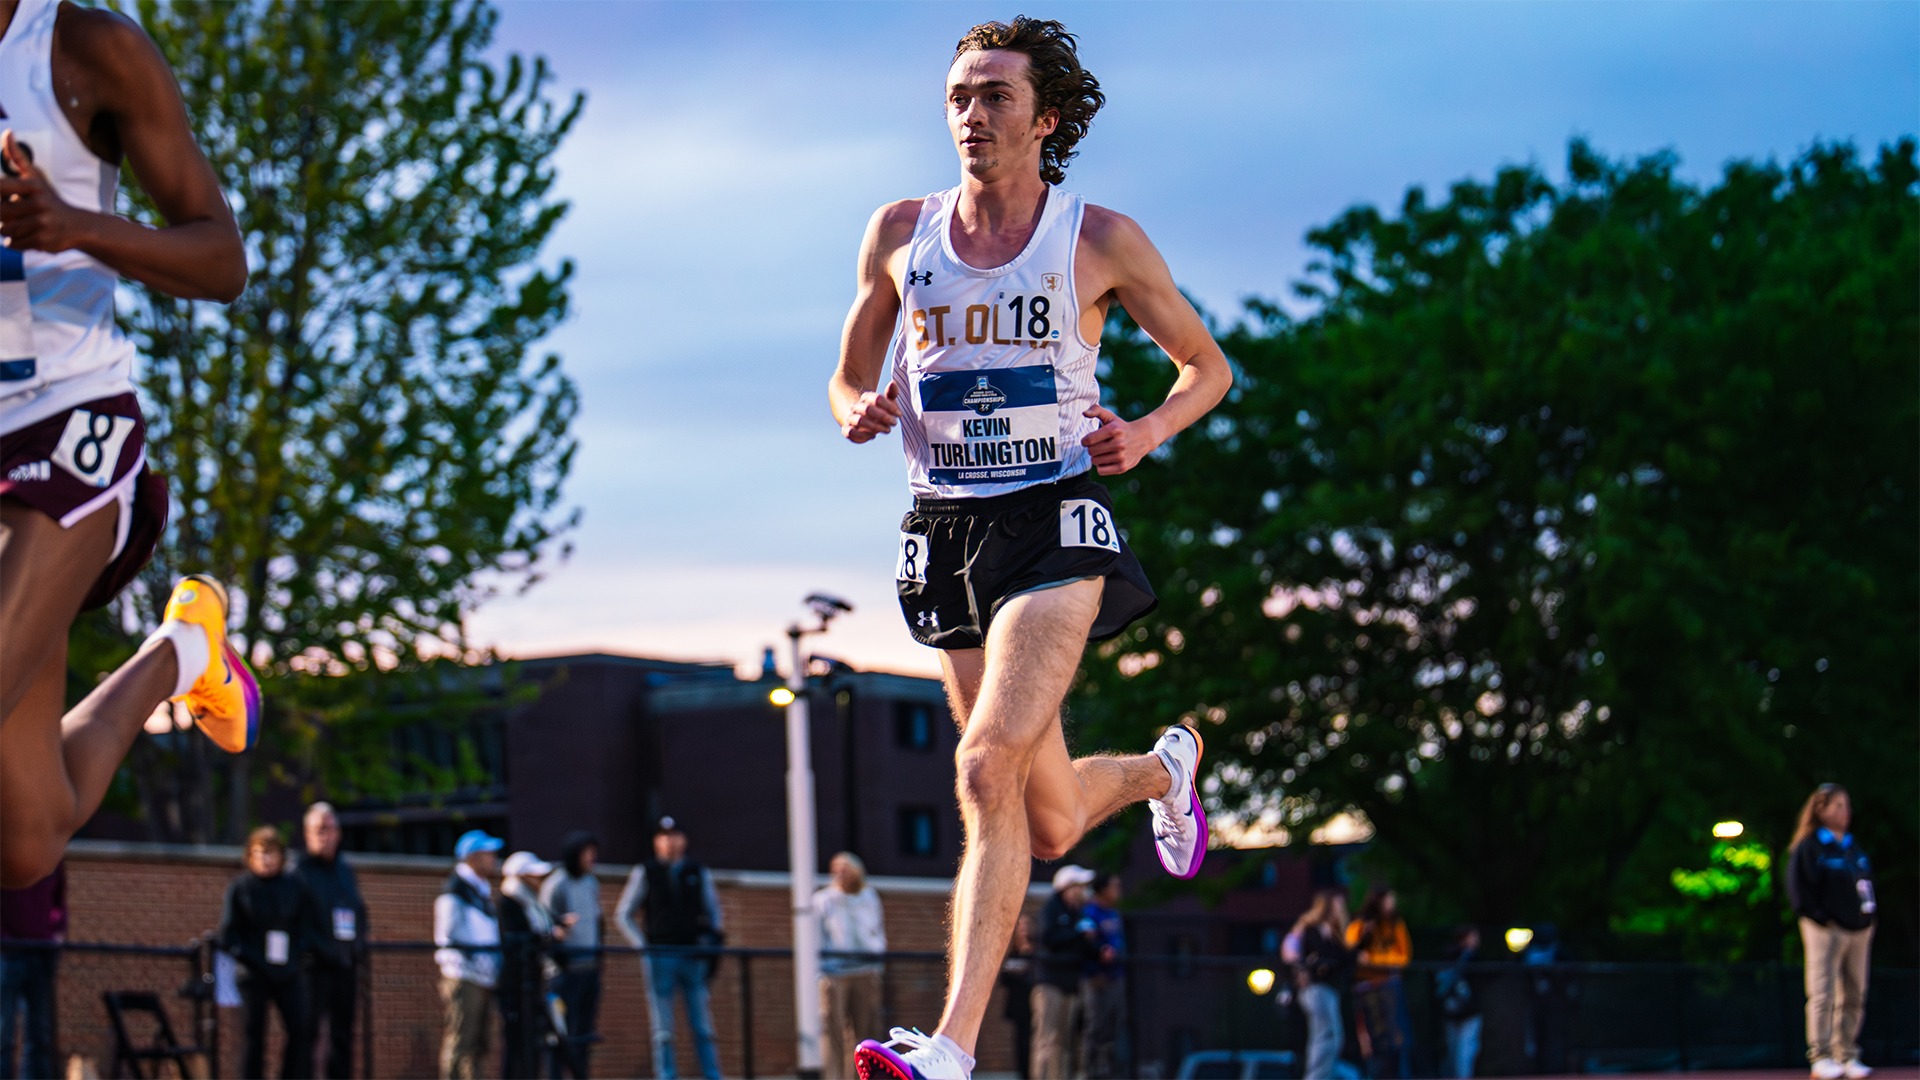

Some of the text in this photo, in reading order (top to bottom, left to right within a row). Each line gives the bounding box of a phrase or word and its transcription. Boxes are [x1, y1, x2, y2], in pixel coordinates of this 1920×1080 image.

[912, 303, 1049, 351] ST. OL
[1008, 295, 1050, 339] 18
[964, 396, 1005, 404] CHAMPIONSHIPS
[74, 411, 114, 474] 8
[962, 417, 1011, 437] KEVIN
[931, 437, 1056, 467] TURLINGTON
[991, 468, 1026, 478] WISCONSIN
[1071, 504, 1111, 547] 18
